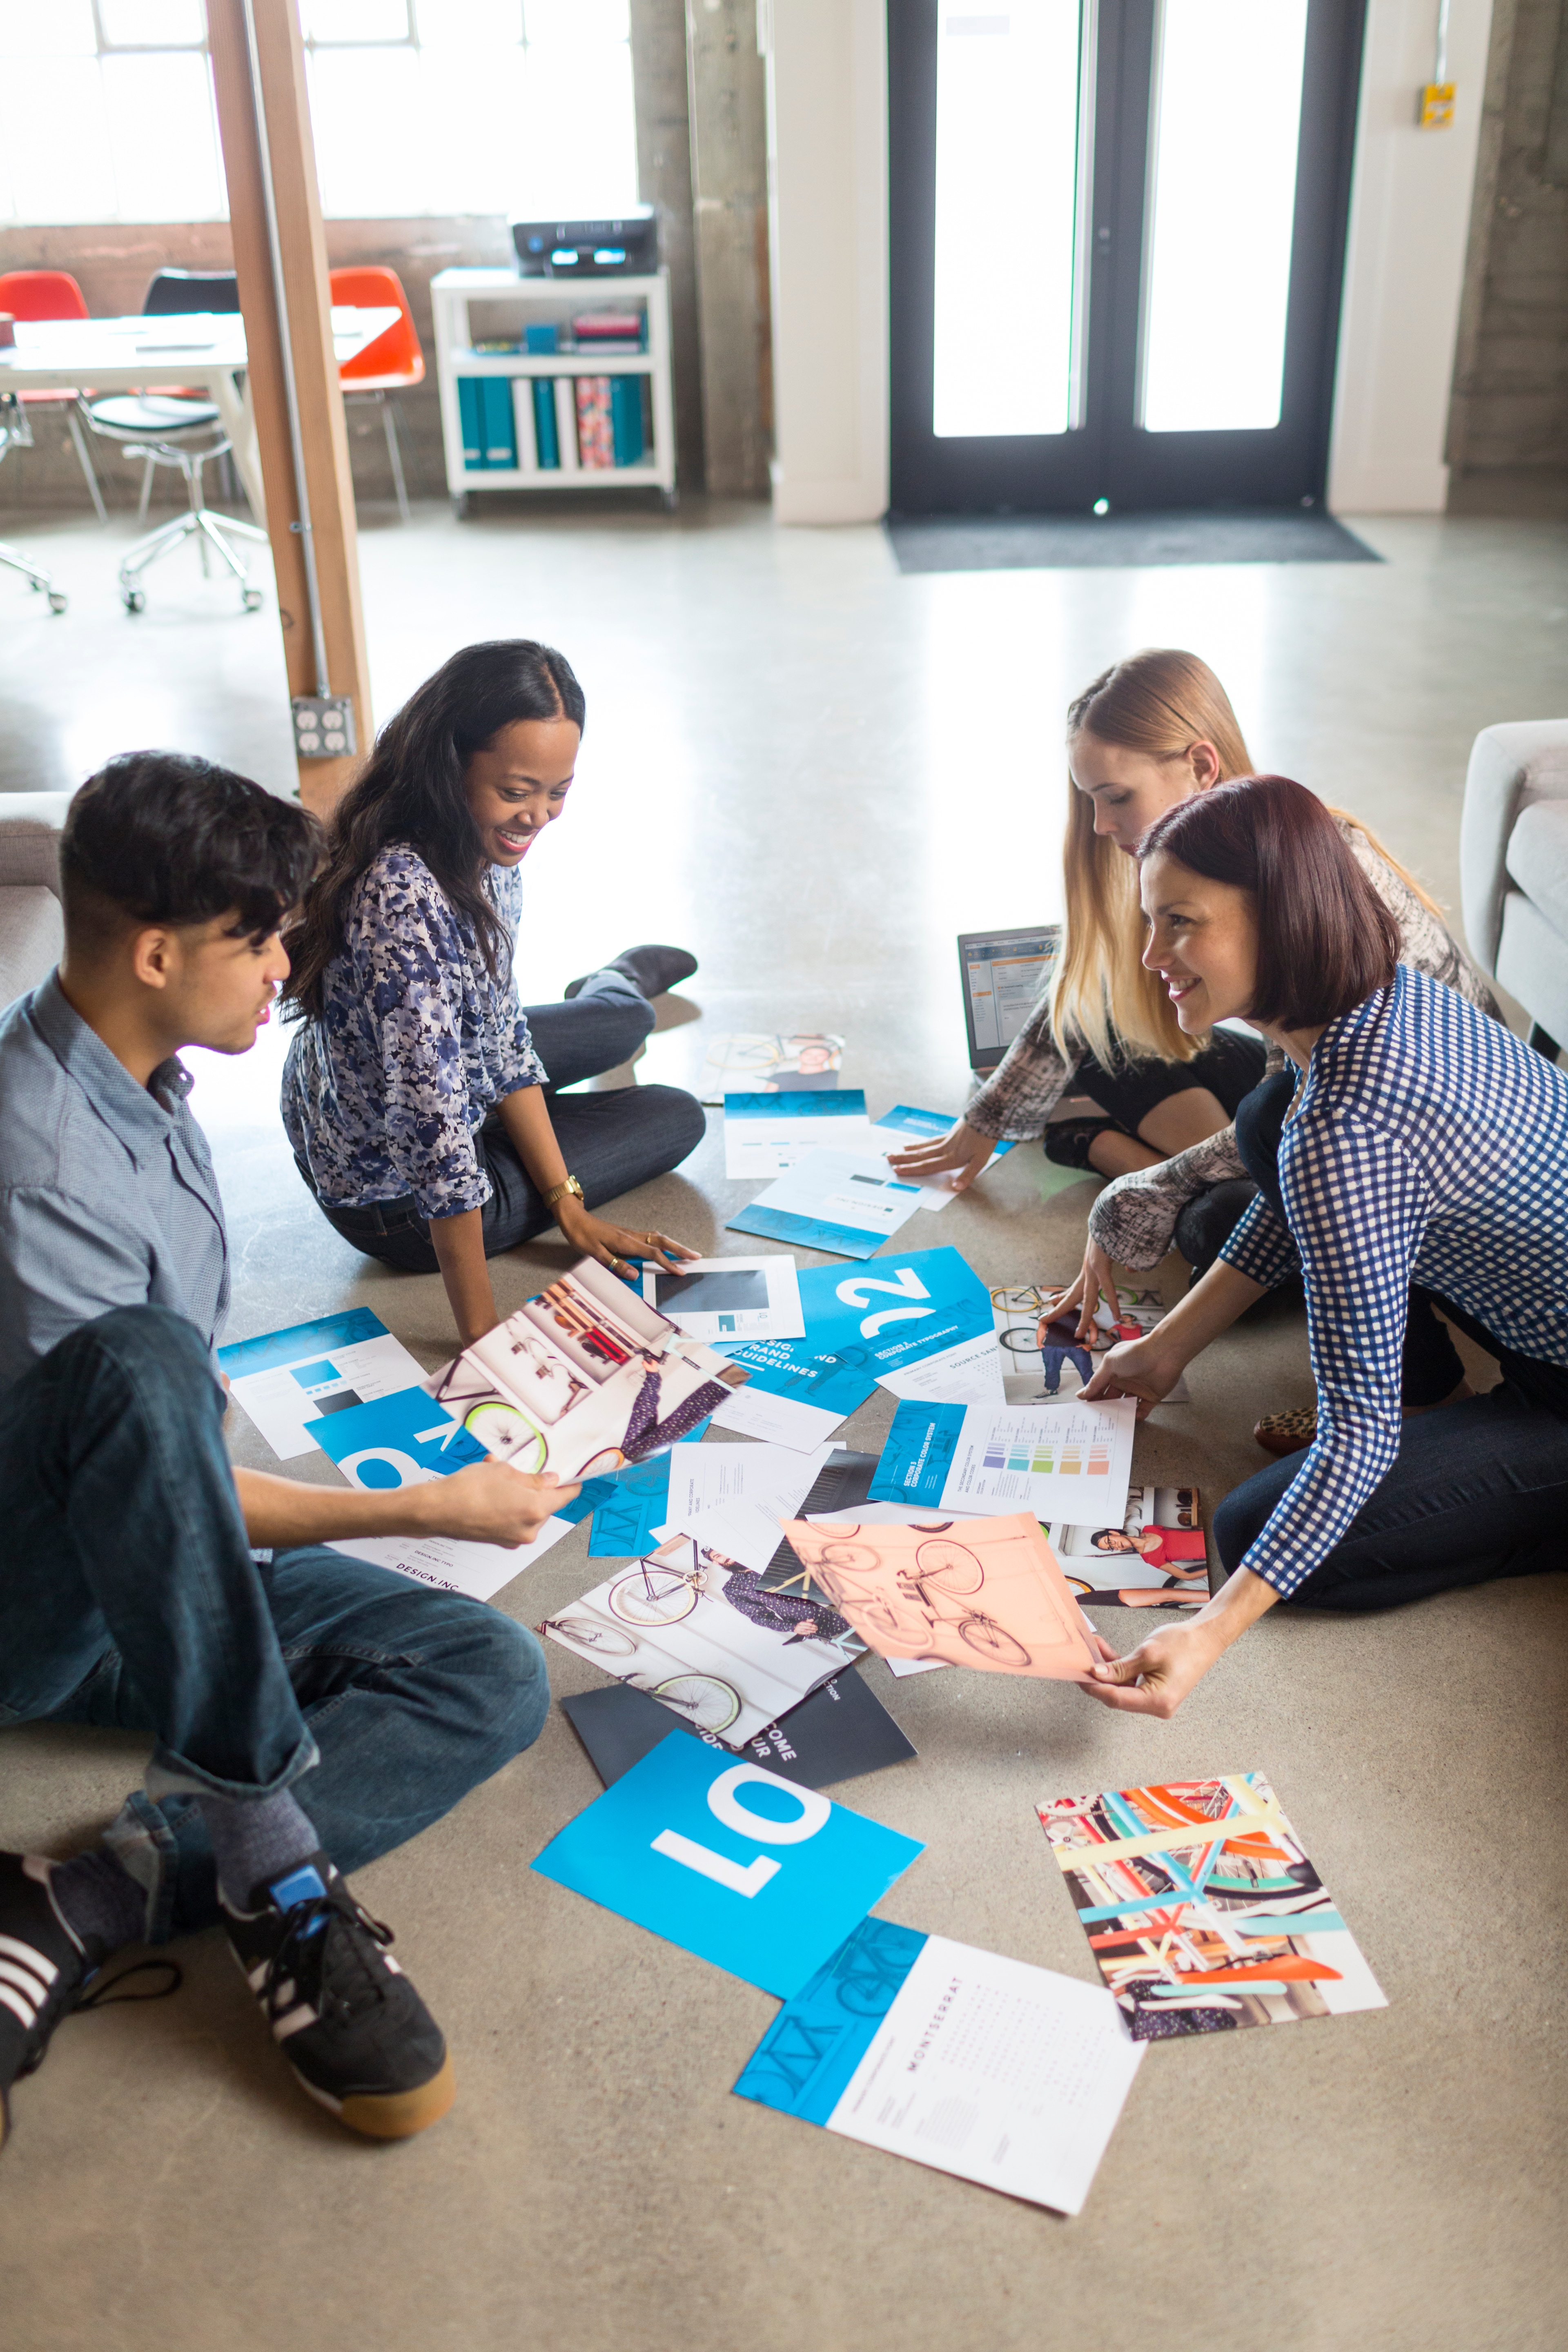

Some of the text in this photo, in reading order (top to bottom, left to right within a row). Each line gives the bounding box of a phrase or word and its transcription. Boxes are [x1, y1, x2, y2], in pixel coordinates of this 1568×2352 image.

[749, 1343, 791, 1360] RAND
[874, 1343, 903, 1357] SECTION
[878, 1325, 959, 1360] CORPORATE TYPOGRAPHY
[949, 1353, 981, 1369] SOURCE
[910, 1422, 936, 1487] CORPORATE COLOR SYSTEM
[903, 1465, 915, 1486] SECTION
[959, 1467, 967, 1485] SECONDARY
[414, 1550, 441, 1563] DESIGN.INC
[396, 1562, 459, 1592] DESIGN.INC
[750, 1733, 771, 1758] UR
[650, 1762, 832, 1899] 01
[905, 1976, 964, 2074] MONTSERRAT
